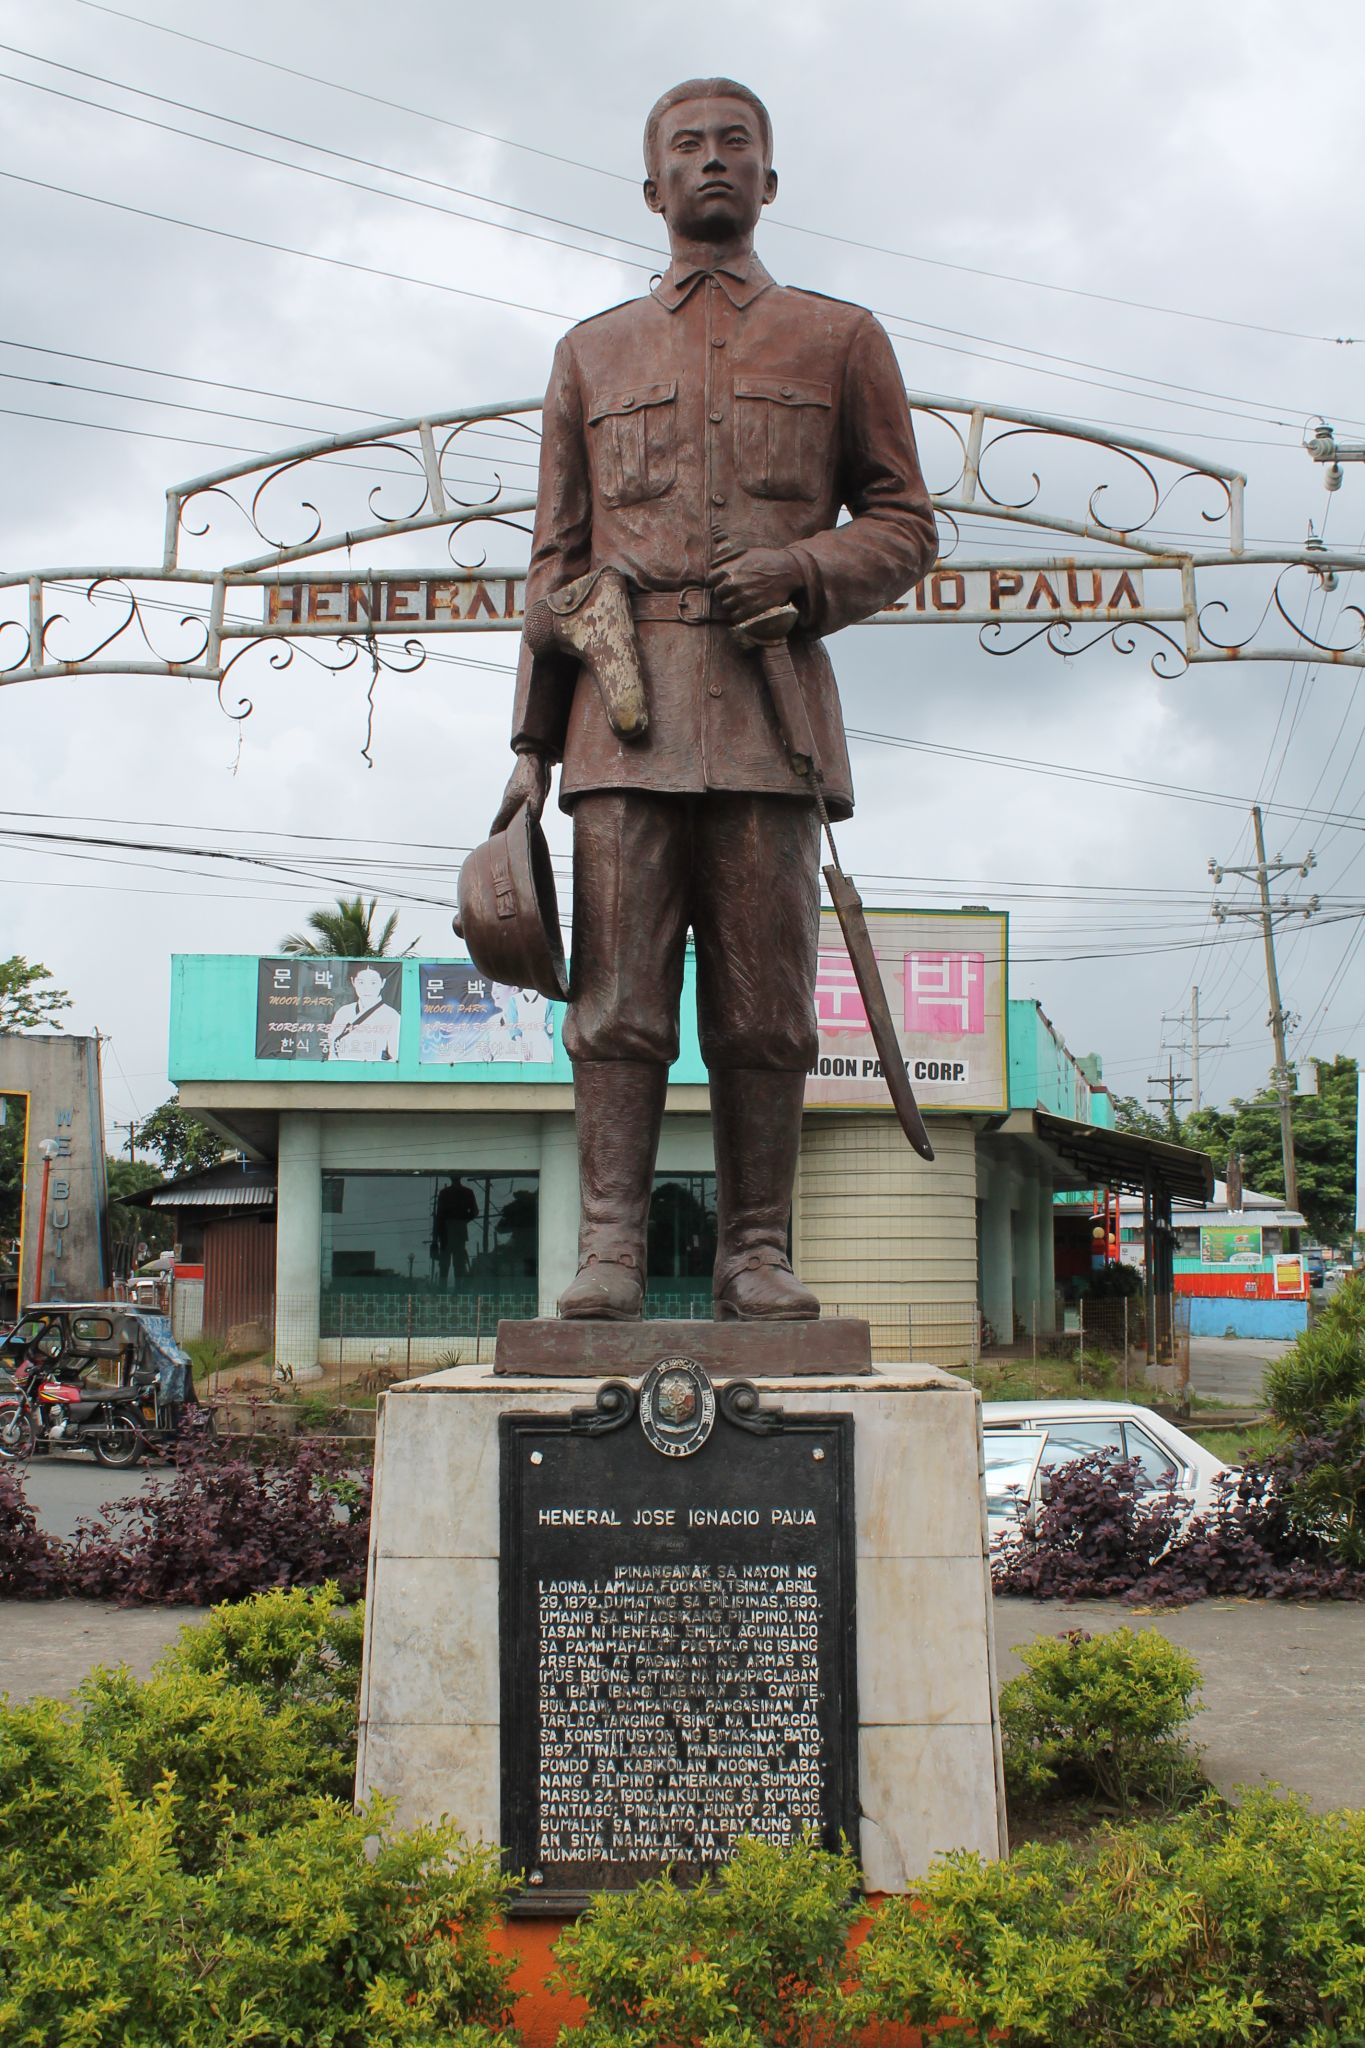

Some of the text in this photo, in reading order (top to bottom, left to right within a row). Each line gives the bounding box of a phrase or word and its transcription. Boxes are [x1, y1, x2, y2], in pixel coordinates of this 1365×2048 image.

[269, 581, 524, 625] HENERAL
[990, 568, 1142, 610] PAUA
[273, 968, 334, 990] 문 박
[426, 979, 487, 999] 문 박
[912, 956, 977, 1030] 박
[268, 996, 336, 1007] MOON PARK
[424, 1004, 488, 1014] MOON PARK
[268, 1022, 315, 1033] KOREAN
[281, 1038, 310, 1053] 한식
[915, 1061, 965, 1081] CORP.
[50, 1179, 70, 1302] BUIL
[538, 1509, 817, 1526] HENERAL JOSE IGNACIO PAUA
[614, 1565, 817, 1579] IPINANGANAK SA NAYON NG
[776, 1580, 817, 1593] ABRIL
[540, 1596, 562, 1609] 29,
[604, 1596, 676, 1608] DUMATING
[683, 1596, 700, 1608] SA
[785, 1595, 822, 1608] 1890.
[540, 1611, 594, 1624] UMANIB
[600, 1611, 618, 1624] SA
[728, 1610, 792, 1624] PILIPINO.
[795, 1610, 823, 1623] INA-
[540, 1624, 818, 1639] TASAN NI HENERAL EMILIO AGUINALDO
[540, 1641, 558, 1653] SA
[753, 1640, 773, 1652] NG
[777, 1639, 818, 1652] ISANG
[540, 1655, 605, 1669] ARSENAL
[613, 1655, 629, 1668] AT
[718, 1654, 738, 1668] NG
[747, 1654, 795, 1668] ARMAS
[801, 1654, 818, 1667] SA
[691, 1669, 709, 1683] NA
[540, 1684, 557, 1698] SA
[566, 1684, 600, 1698] IBA'T
[740, 1684, 756, 1697] SA
[802, 1699, 819, 1712] AT
[725, 1714, 744, 1727] NA
[752, 1714, 819, 1727] LUMAGDA
[540, 1730, 557, 1743] SA
[564, 1730, 675, 1743] KONSTITUSYON
[682, 1729, 701, 1743] NG
[798, 1743, 820, 1757] NG
[540, 1759, 589, 1773] PONDO
[597, 1759, 616, 1773] SA
[717, 1758, 769, 1772] NOONG
[540, 1774, 582, 1788] NANG
[540, 1789, 589, 1802] MARSO
[657, 1789, 734, 1802] NAKULONG
[742, 1788, 759, 1802] SA
[764, 1788, 820, 1801] KUTANG
[704, 1804, 753, 1817] HUNYO
[540, 1819, 603, 1832] BUMALIK
[613, 1819, 631, 1832] SA
[701, 1819, 746, 1832] ALBAY
[751, 1818, 791, 1832] KUNG
[540, 1834, 560, 1847] AN
[571, 1834, 603, 1847] SIYA
[613, 1834, 681, 1847] NAHALAL
[694, 1833, 715, 1847] NA
[701, 1848, 739, 1862] MAYO
